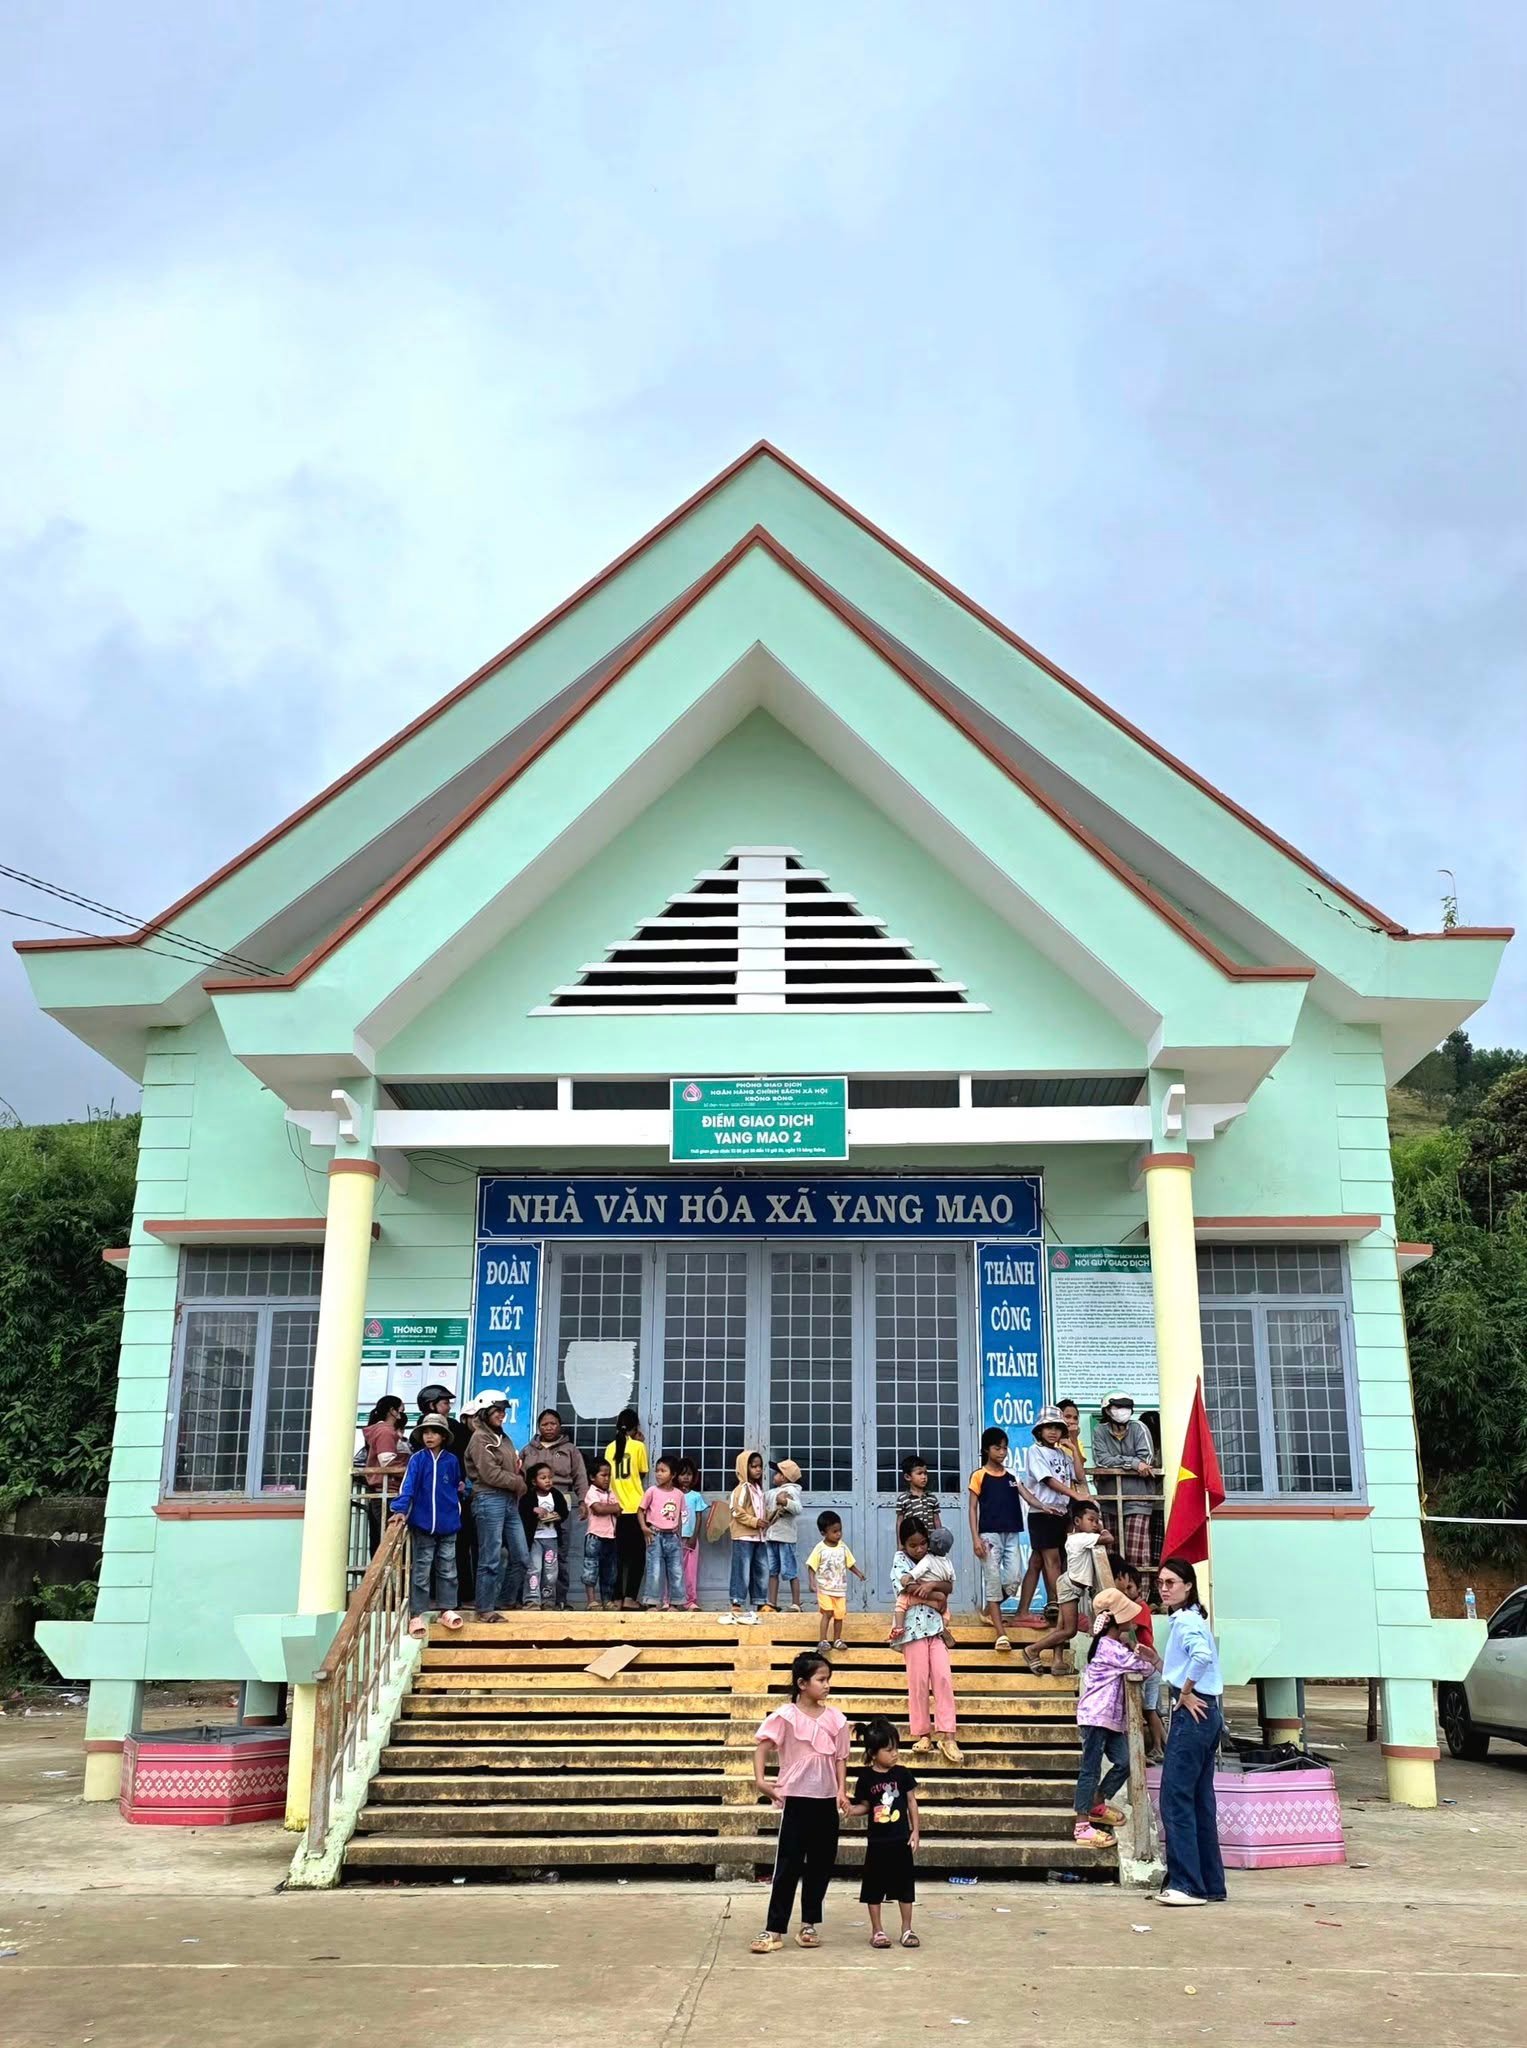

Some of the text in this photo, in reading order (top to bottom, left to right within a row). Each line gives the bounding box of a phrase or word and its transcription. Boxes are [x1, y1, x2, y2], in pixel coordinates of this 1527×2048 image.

[714, 1130, 802, 1145] YANG MAO 2
[739, 1114, 775, 1128] GIAO
[779, 1114, 814, 1129] DỊCH
[507, 1186, 1014, 1224] NHÀ VĂN HÓA XÃ YANG MAO
[486, 1254, 531, 1285] ĐOÀN
[985, 1254, 1035, 1286] THÀNH
[1091, 1259, 1107, 1267] QUY
[1108, 1259, 1128, 1267] GIAO
[1129, 1259, 1150, 1268] DỊCH
[489, 1294, 524, 1331] KẾT
[991, 1300, 1031, 1332] CÔNG
[392, 1325, 423, 1334] THÔNG
[424, 1325, 438, 1334] TIN
[481, 1345, 527, 1377] ĐOÀN
[986, 1345, 1038, 1378] THÀNH
[993, 1392, 1035, 1425] CÔNG
[615, 1453, 631, 1479] 10
